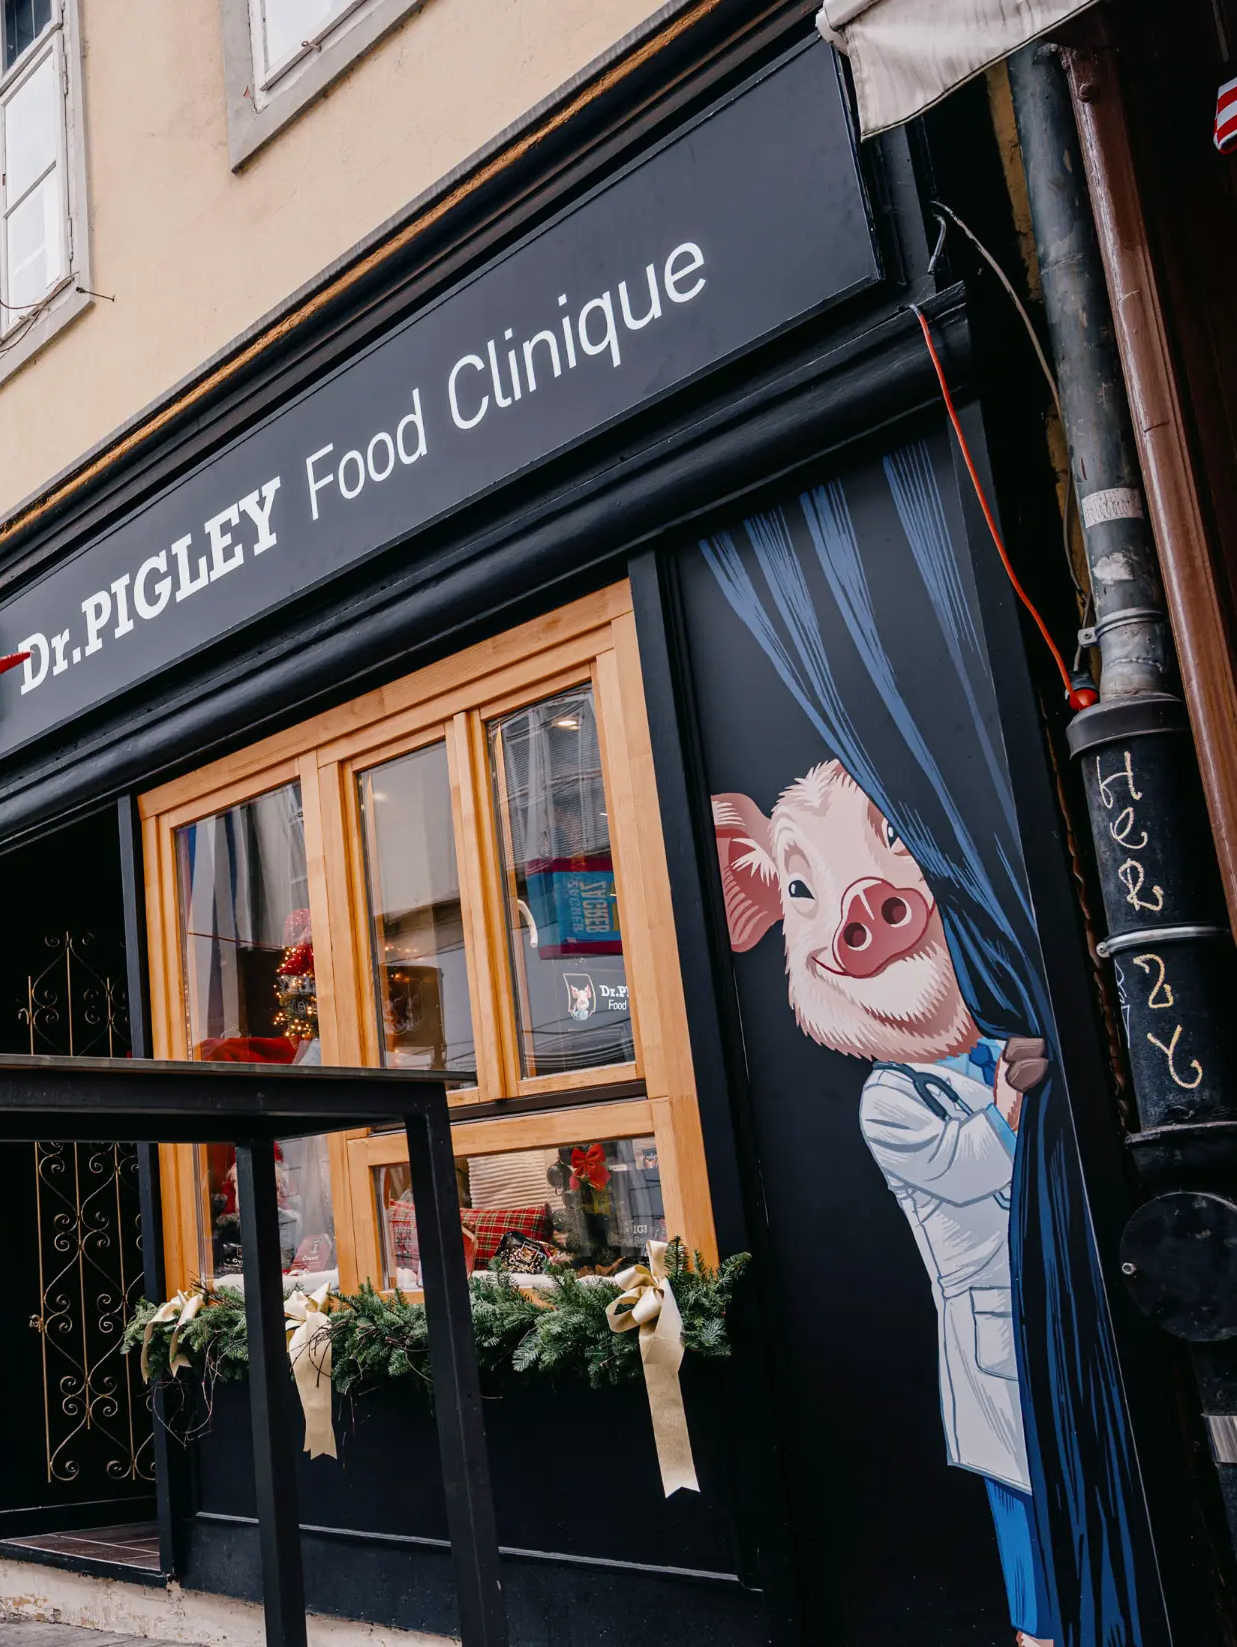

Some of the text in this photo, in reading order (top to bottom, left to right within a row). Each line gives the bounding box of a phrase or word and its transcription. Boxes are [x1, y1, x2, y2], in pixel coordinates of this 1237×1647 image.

[18, 241, 707, 695] Dr.PIGLEY Food Clinique
[609, 999, 627, 1010] Food
